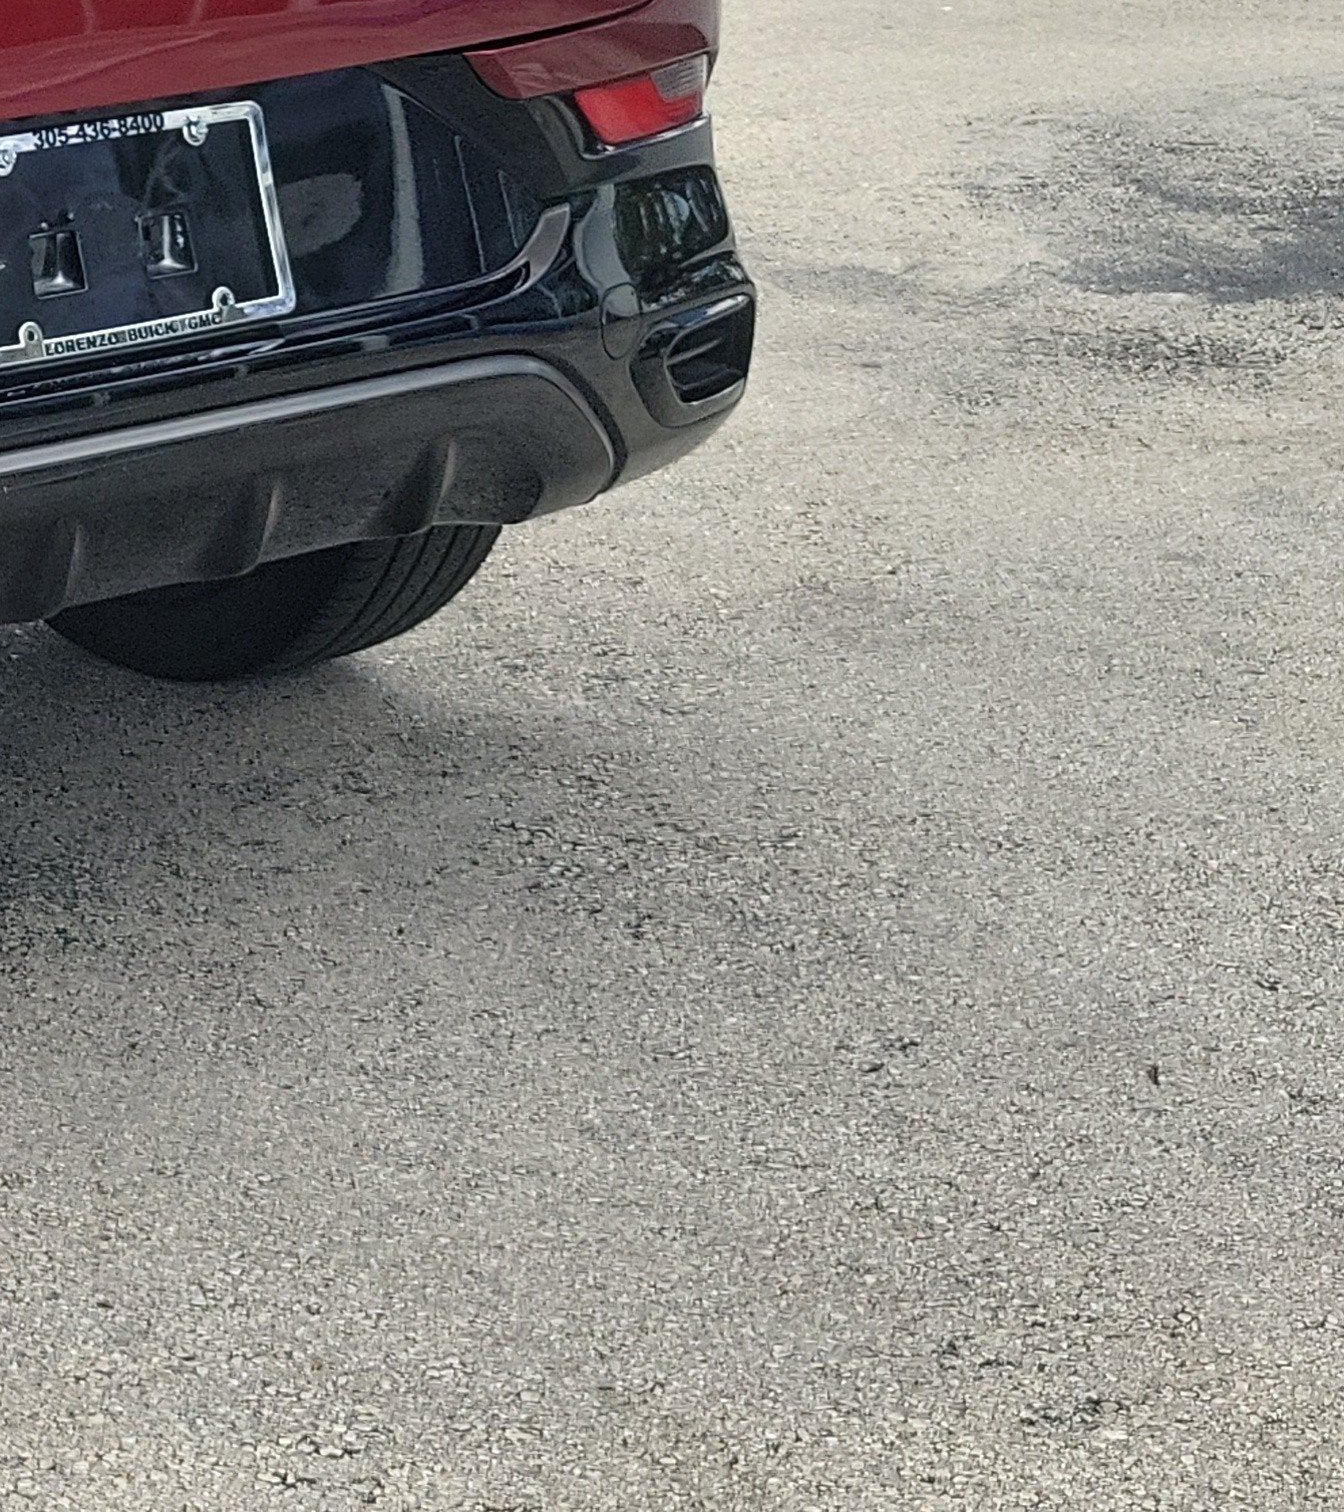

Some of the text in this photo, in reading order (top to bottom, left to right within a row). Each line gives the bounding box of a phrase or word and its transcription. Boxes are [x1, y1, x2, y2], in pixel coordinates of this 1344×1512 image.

[44, 312, 223, 357] LORENZO BUICK GMC
